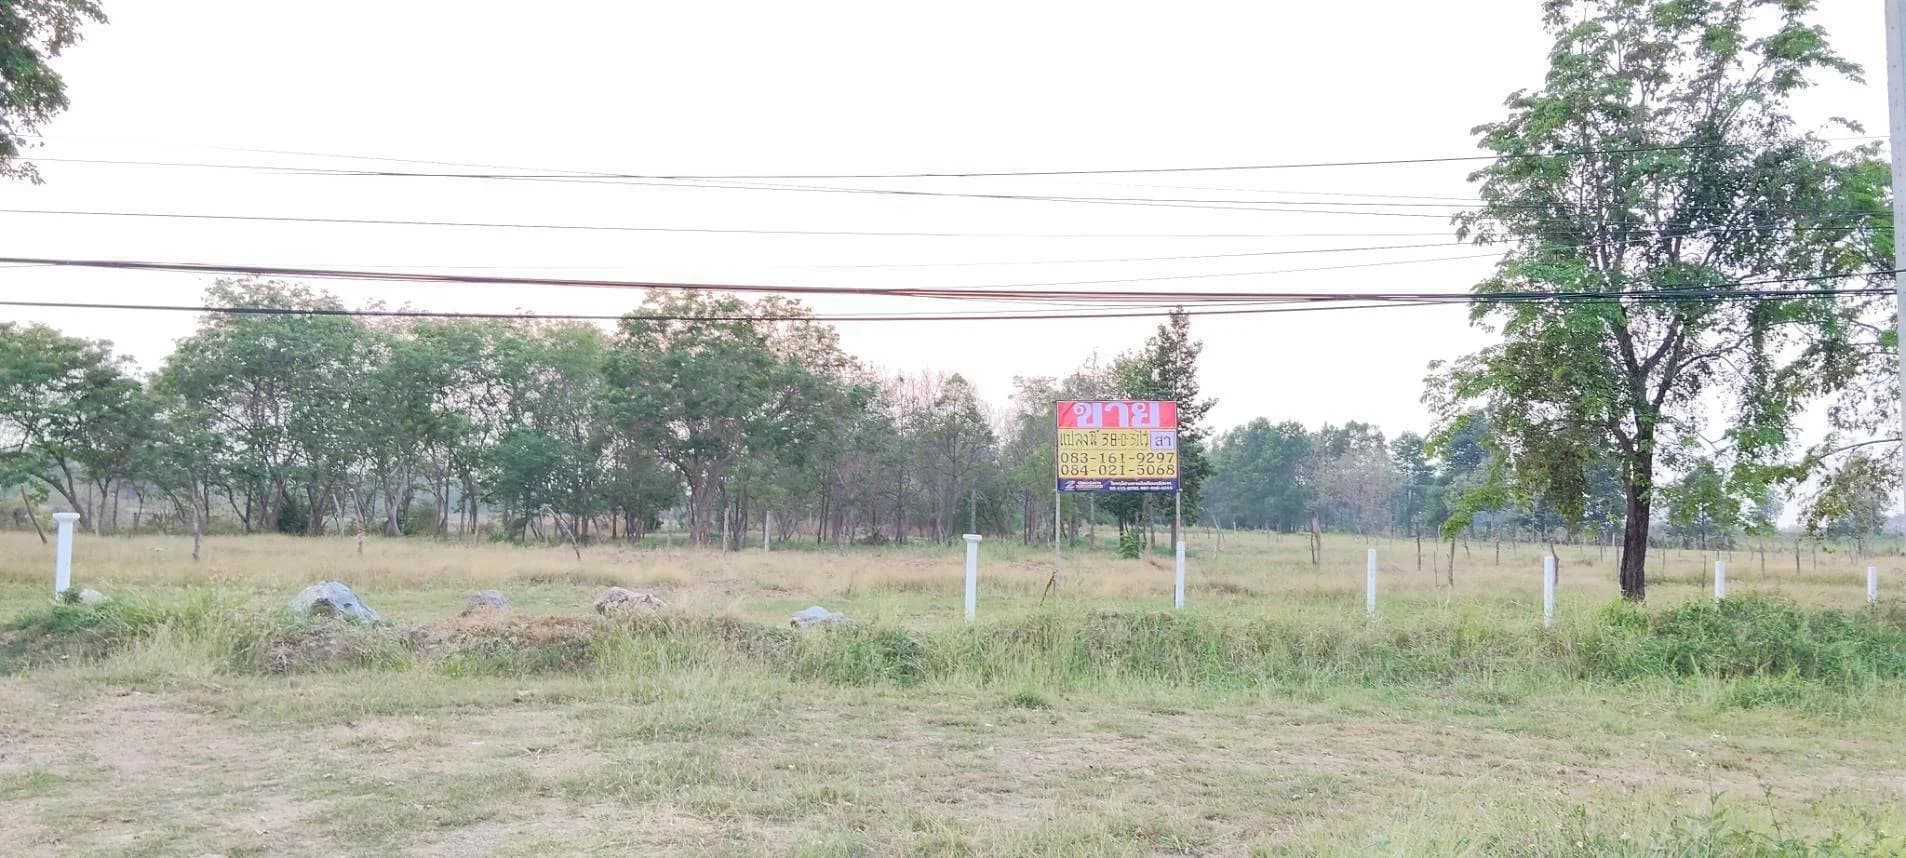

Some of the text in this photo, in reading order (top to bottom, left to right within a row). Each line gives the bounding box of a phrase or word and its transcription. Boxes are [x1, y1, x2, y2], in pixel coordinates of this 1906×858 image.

[1073, 402, 1159, 427] ขาย
[1060, 452, 1175, 463] 083-161-9297
[1060, 464, 1175, 476] 084-021-5068
